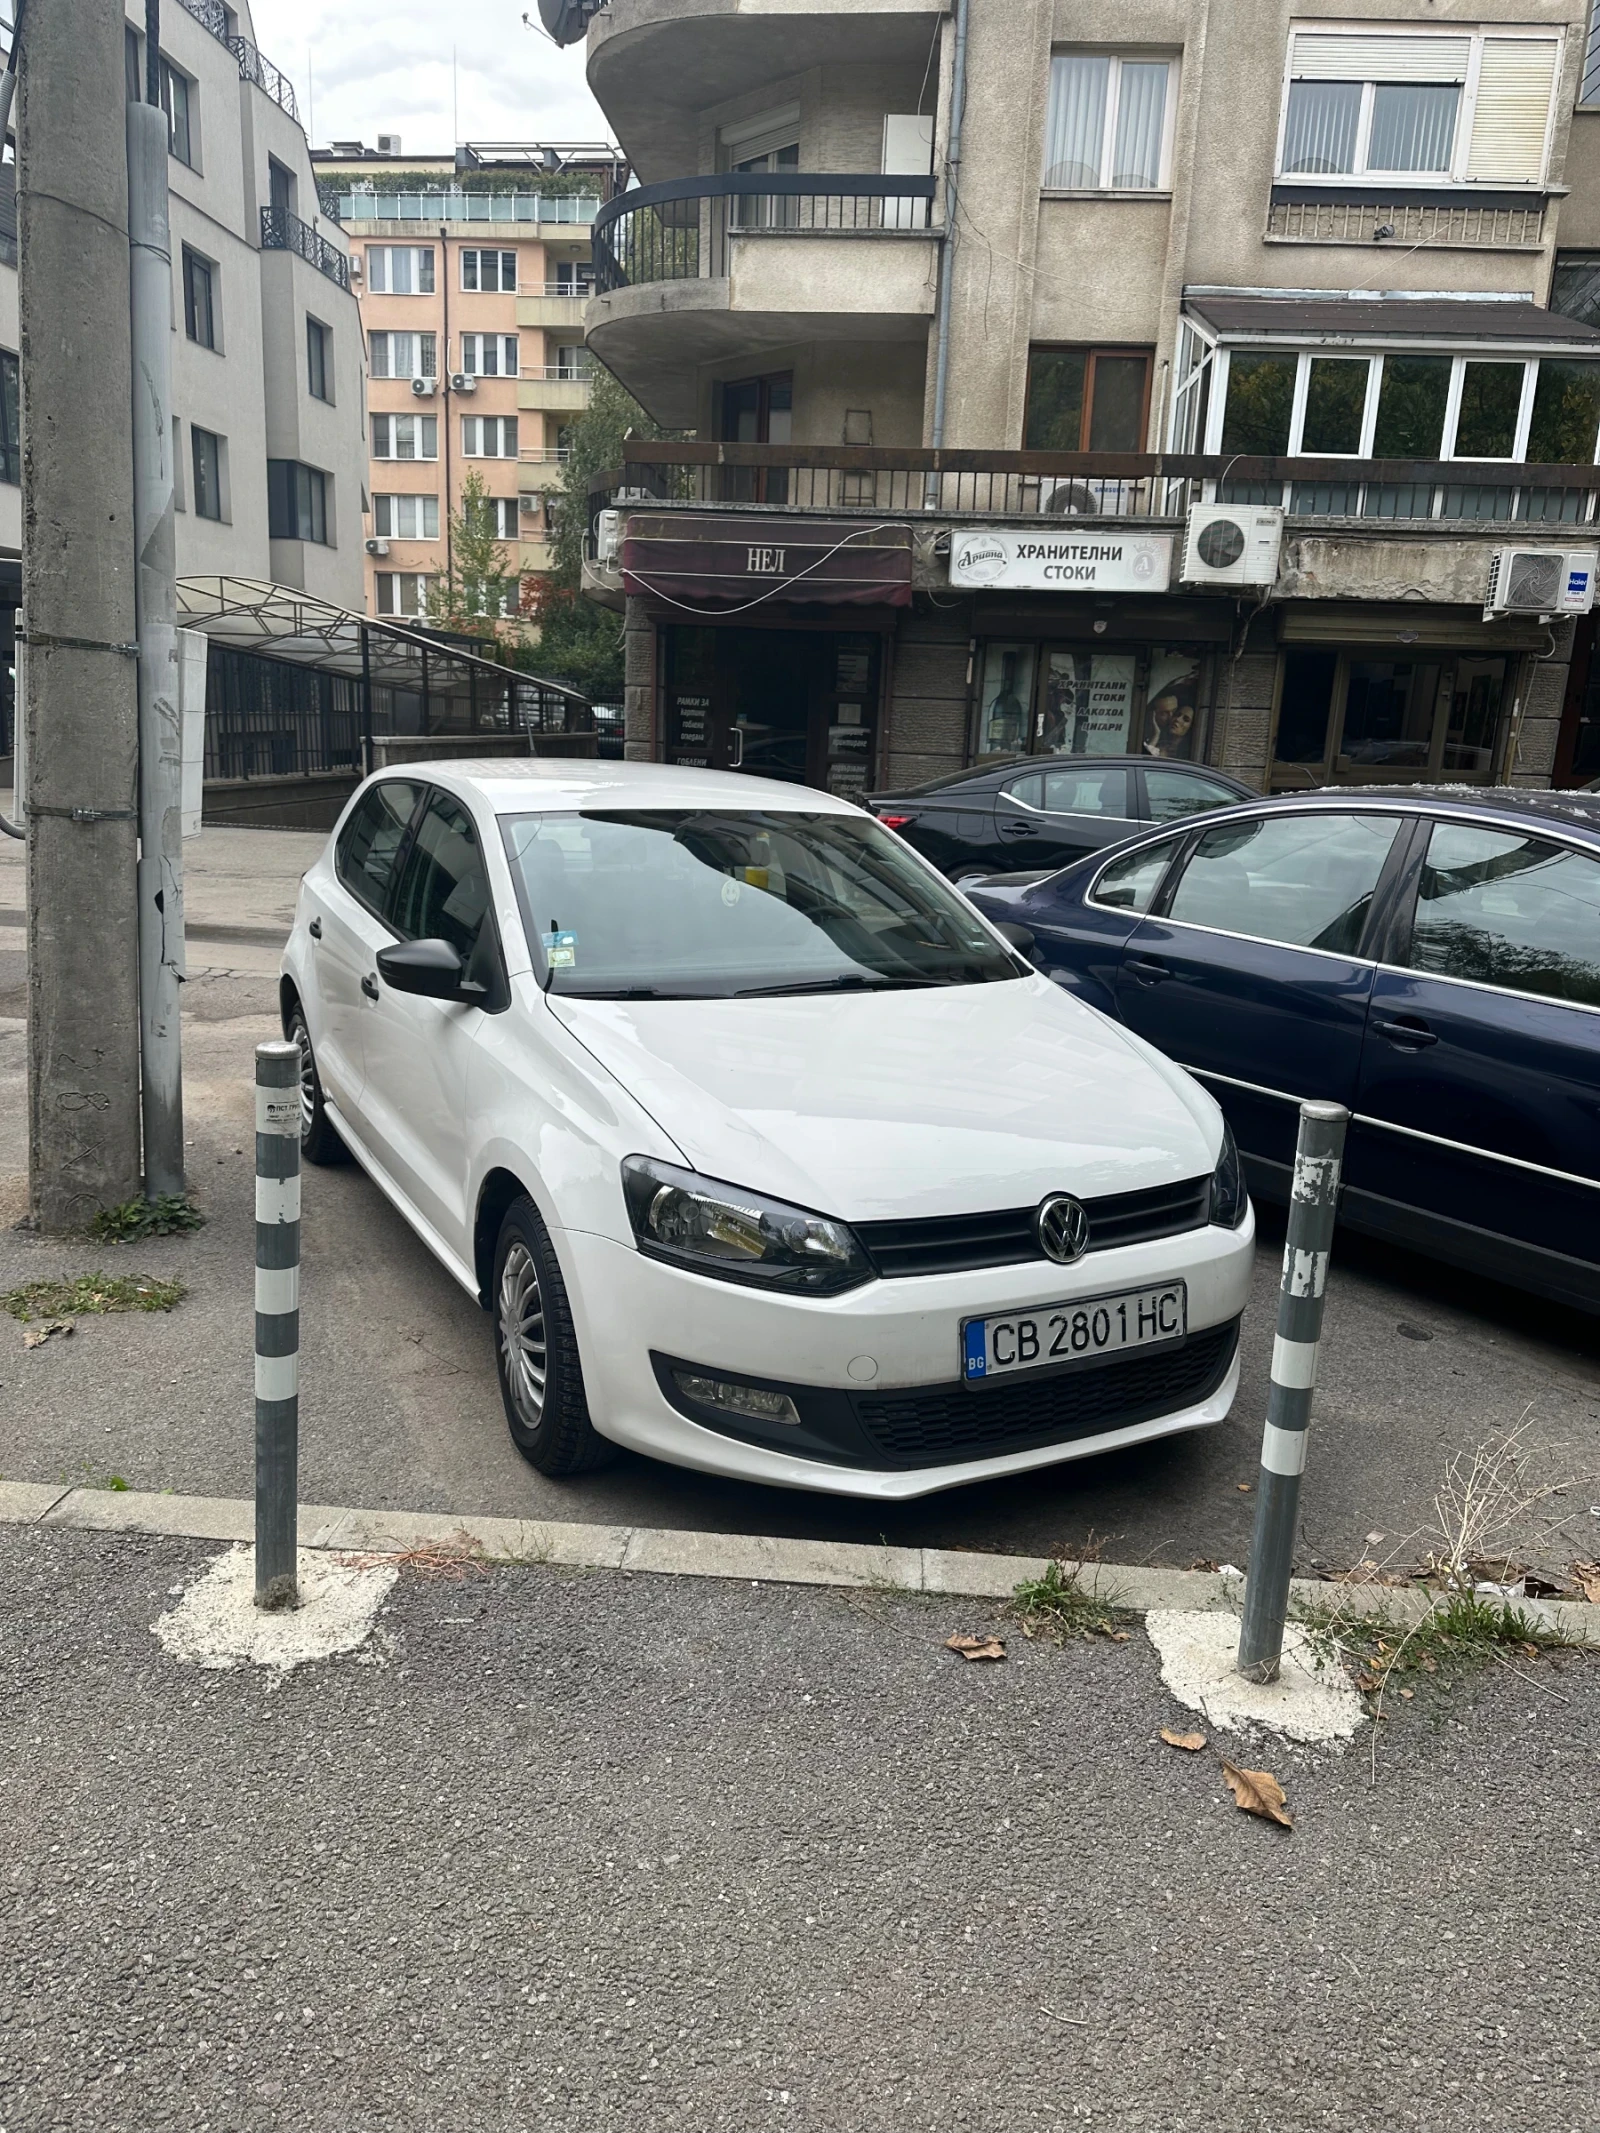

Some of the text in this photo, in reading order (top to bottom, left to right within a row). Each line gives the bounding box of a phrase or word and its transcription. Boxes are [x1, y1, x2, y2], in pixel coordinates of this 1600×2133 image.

[1016, 544, 1123, 561] ХРАНИТЕЛНИ
[746, 547, 786, 573] НЕЛ
[958, 551, 1003, 569] Ариана
[1043, 565, 1096, 580] СТОКИ
[1058, 680, 1127, 690] ХРАНИТЕЛНИ
[676, 697, 710, 706] РАМКИ ЗА
[1092, 693, 1126, 702] СТОКИ
[1077, 707, 1124, 717] АЛКОХОЛ
[1081, 722, 1123, 732] ЦИГАРИ
[992, 1293, 1178, 1365] CB 2801 HC
[968, 1357, 985, 1370] BG
